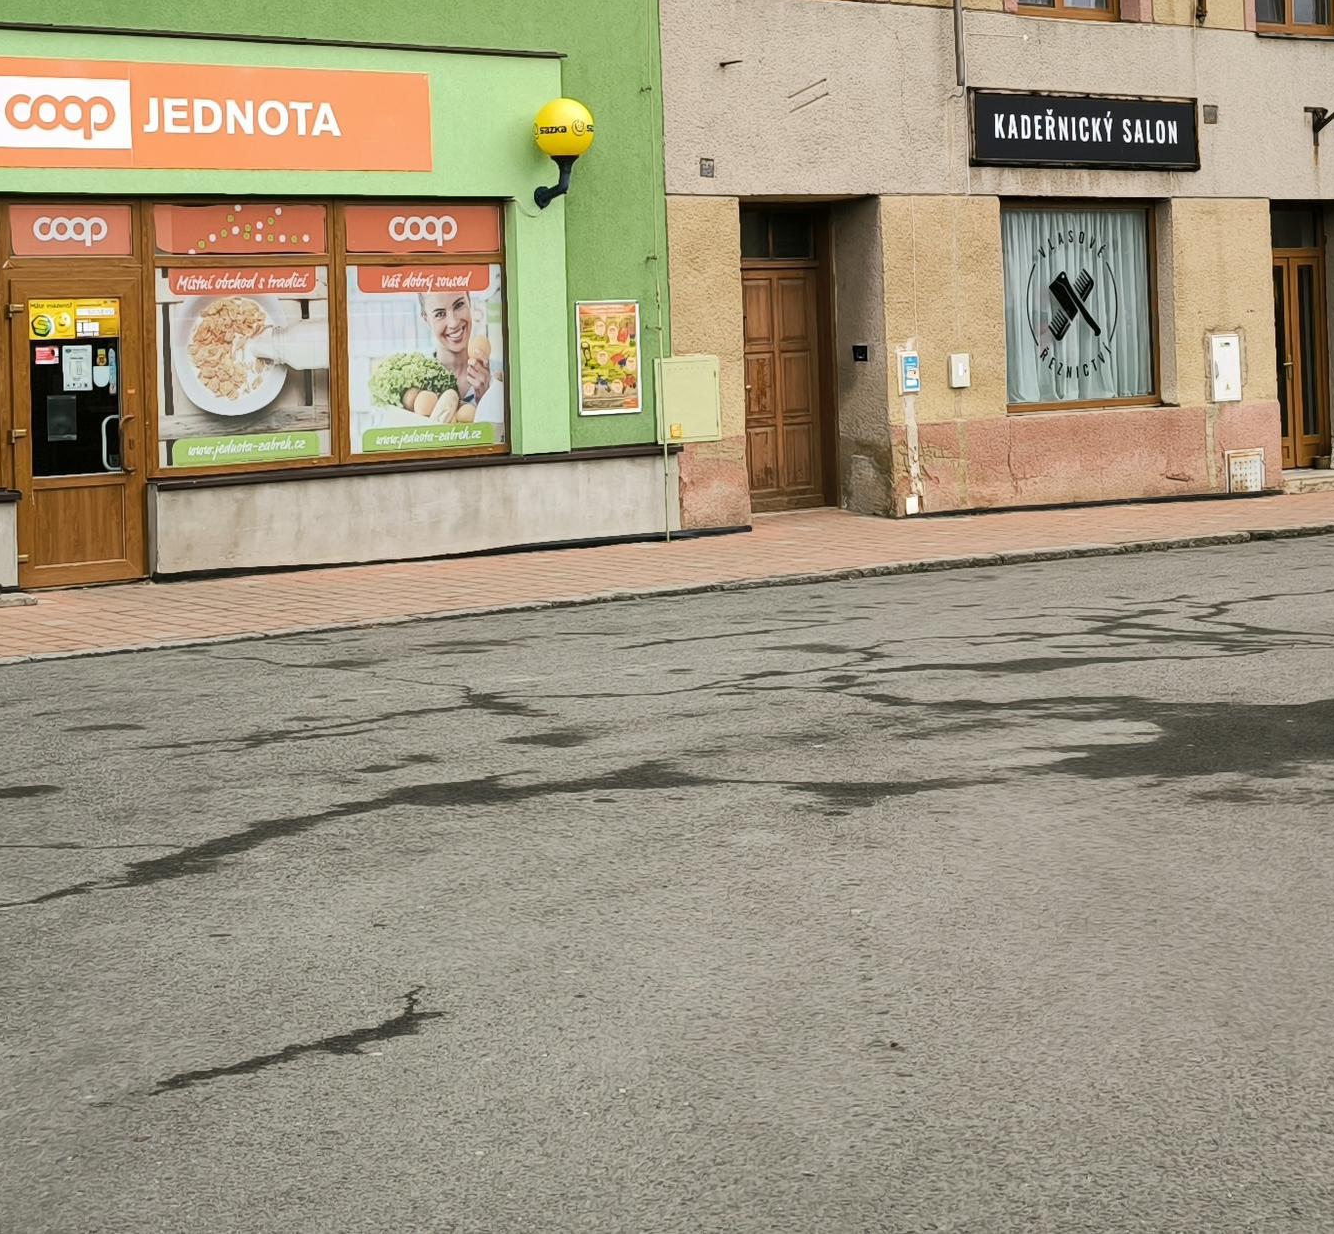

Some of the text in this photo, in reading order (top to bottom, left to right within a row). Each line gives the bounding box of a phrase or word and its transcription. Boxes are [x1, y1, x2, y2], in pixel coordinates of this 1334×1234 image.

[4, 94, 342, 140] coop JEDNOTA
[994, 108, 1178, 145] KADEŘNICKÝ SALON
[33, 216, 108, 247] coop
[388, 215, 458, 247] coop
[1038, 230, 1107, 258] VLASOVÉ
[176, 271, 309, 291] Místní obchod s tradicí
[381, 271, 472, 294] Váš dobrý soused
[1039, 342, 1112, 378] ŘEZNICTVÍ
[187, 435, 307, 461] www.jednota-zabreh.cz
[376, 426, 482, 449] www.jednota-zabreh.cz
